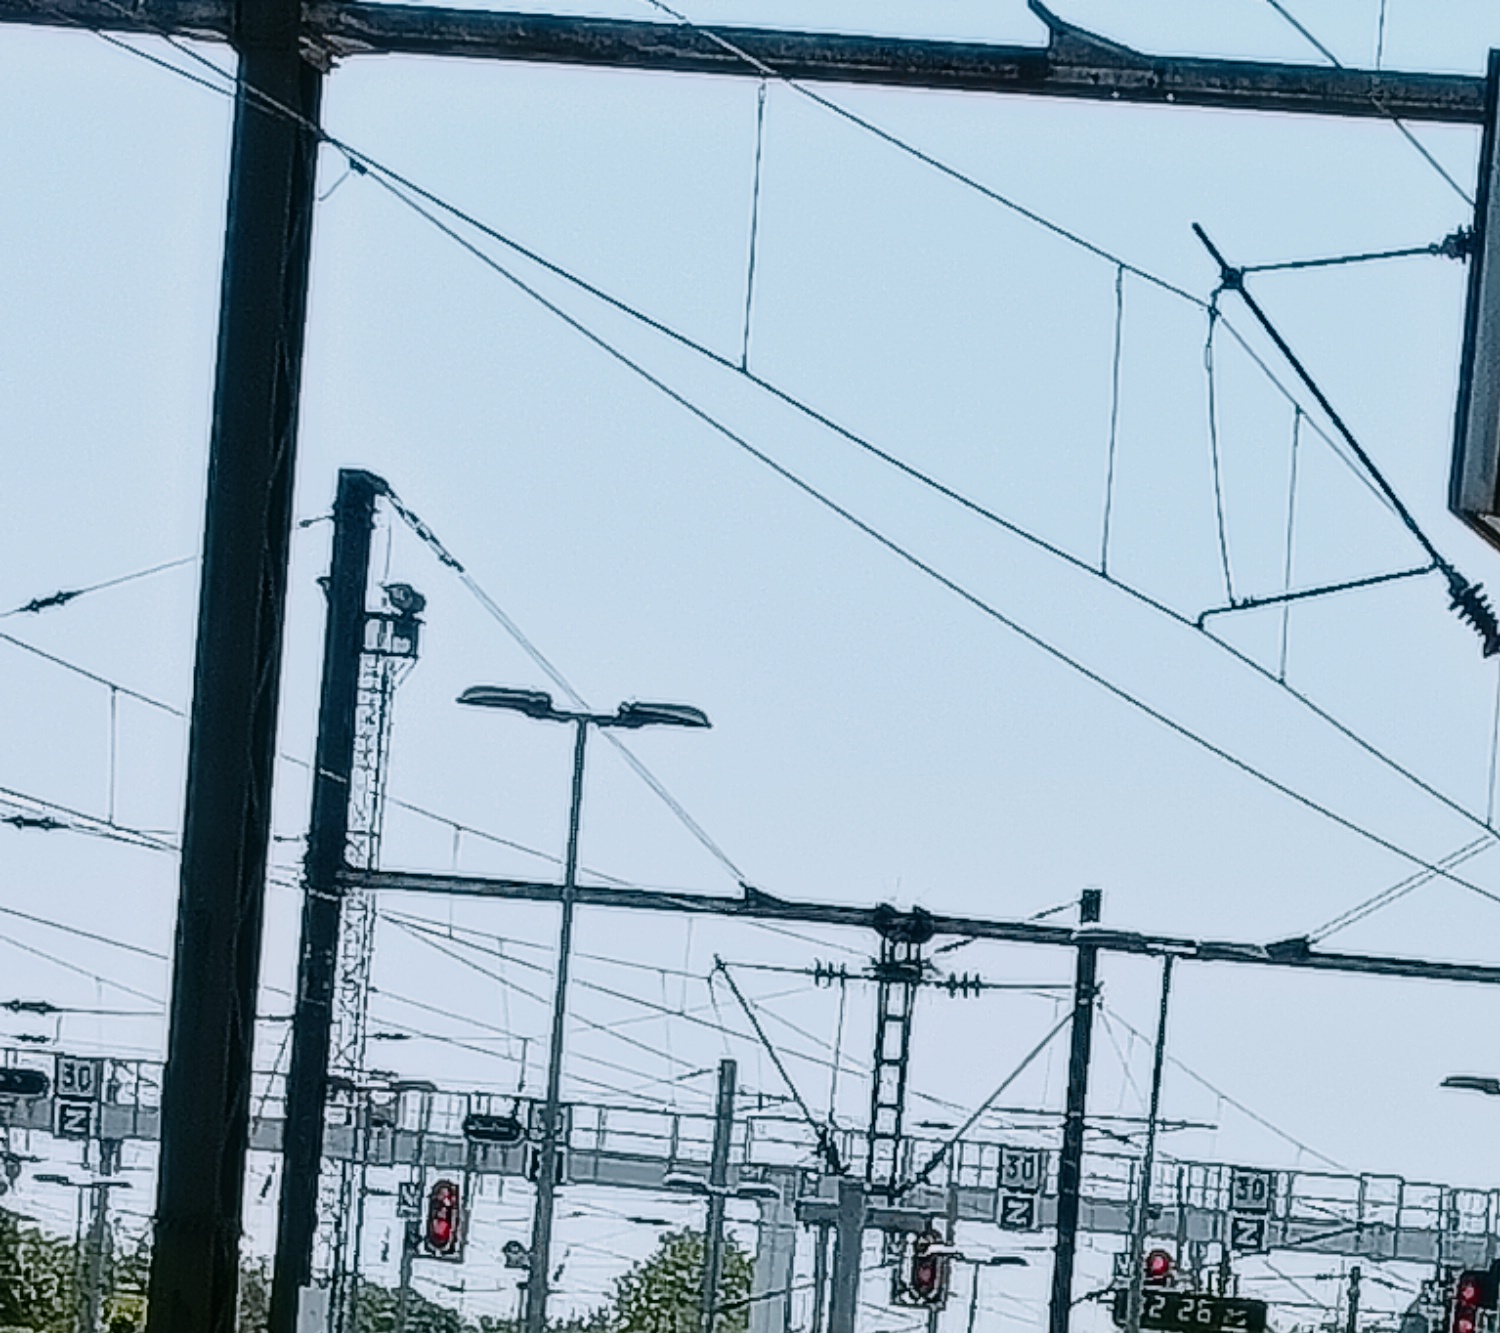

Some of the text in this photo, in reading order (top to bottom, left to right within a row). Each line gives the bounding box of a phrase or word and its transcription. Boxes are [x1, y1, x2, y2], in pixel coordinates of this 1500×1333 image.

[63, 1062, 91, 1092] 30
[1006, 1153, 1036, 1181] 30
[1235, 1175, 1266, 1201] 30
